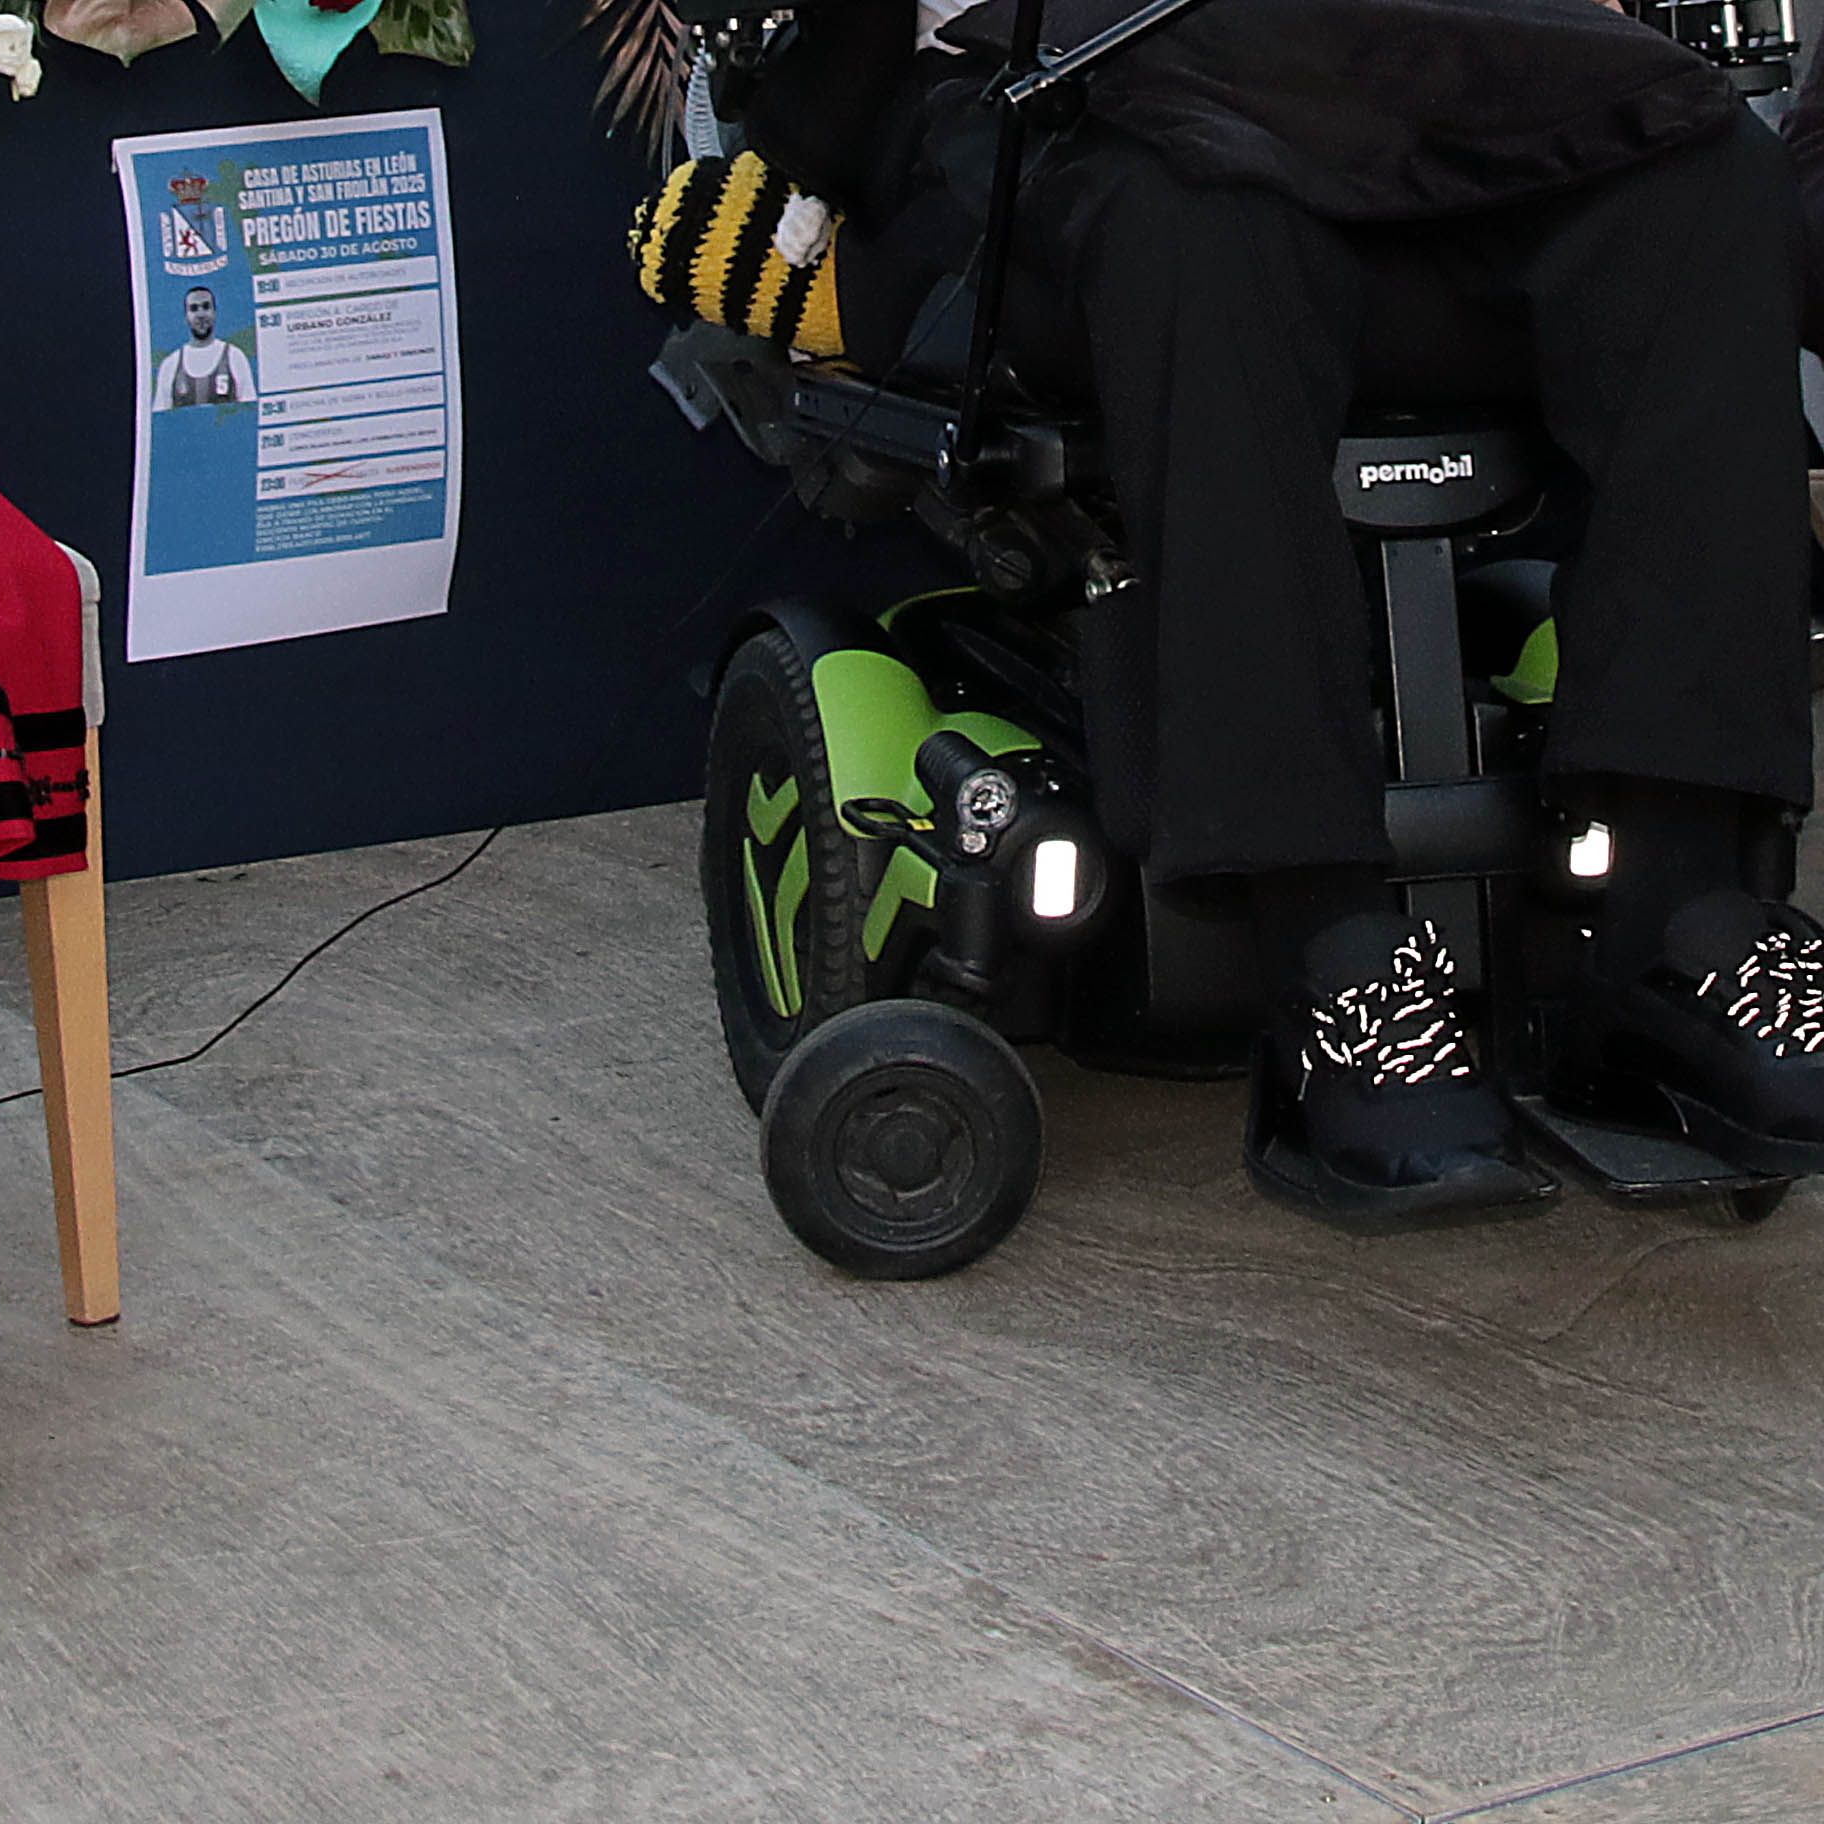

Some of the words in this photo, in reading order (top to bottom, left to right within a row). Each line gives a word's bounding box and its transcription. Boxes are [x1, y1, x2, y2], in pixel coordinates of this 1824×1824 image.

[243, 167, 279, 189] CASA
[281, 165, 298, 185] DE
[301, 159, 362, 183] ASTURIAS
[364, 157, 380, 177] EN
[384, 151, 417, 175] LEÓN
[238, 186, 294, 210] SANTINA
[295, 185, 305, 204] Y
[307, 182, 335, 203] SAN
[391, 173, 426, 194] 2025
[241, 206, 321, 248] PREGÓN
[324, 208, 352, 239] DE
[354, 200, 433, 236] FIESTAS
[259, 247, 318, 266] SÁBADO
[320, 246, 337, 259] 30
[340, 242, 359, 257] DE
[361, 236, 418, 255] AGOSTO
[1360, 454, 1473, 489] permobil
